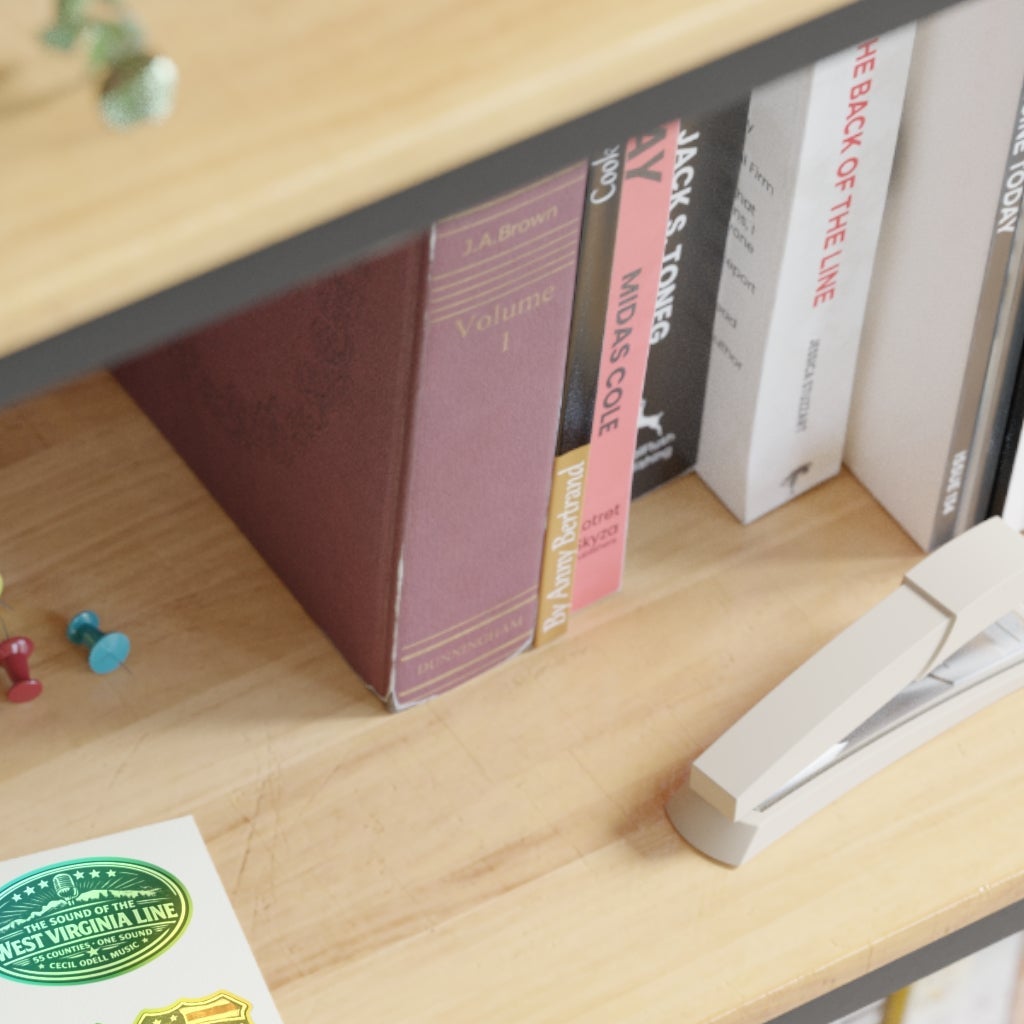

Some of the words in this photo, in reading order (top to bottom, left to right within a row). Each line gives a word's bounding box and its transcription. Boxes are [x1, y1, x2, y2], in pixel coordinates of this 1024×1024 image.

[840, 79, 873, 154] BACK
[670, 129, 700, 211] JACK
[834, 157, 859, 192] OF
[824, 194, 853, 250] THE
[812, 249, 843, 308] LINE
[456, 284, 556, 338] Volume
[609, 266, 642, 364] MIDAS
[597, 367, 626, 437] COLE
[551, 459, 586, 550] Bertrand
[542, 602, 573, 634] By
[24, 919, 48, 934] THE
[50, 908, 92, 926] SOUND
[94, 904, 111, 915] OF
[111, 900, 136, 911] THE
[45, 913, 133, 944] VIRGINIA
[132, 902, 179, 924] LINE
[32, 954, 46, 964] 55
[47, 942, 91, 960] COUNTIES
[97, 935, 118, 946] ONE
[119, 928, 153, 942] SOUND
[49, 960, 78, 970] CECIL
[79, 954, 109, 967] ODELL
[110, 941, 140, 960] MUSIC
